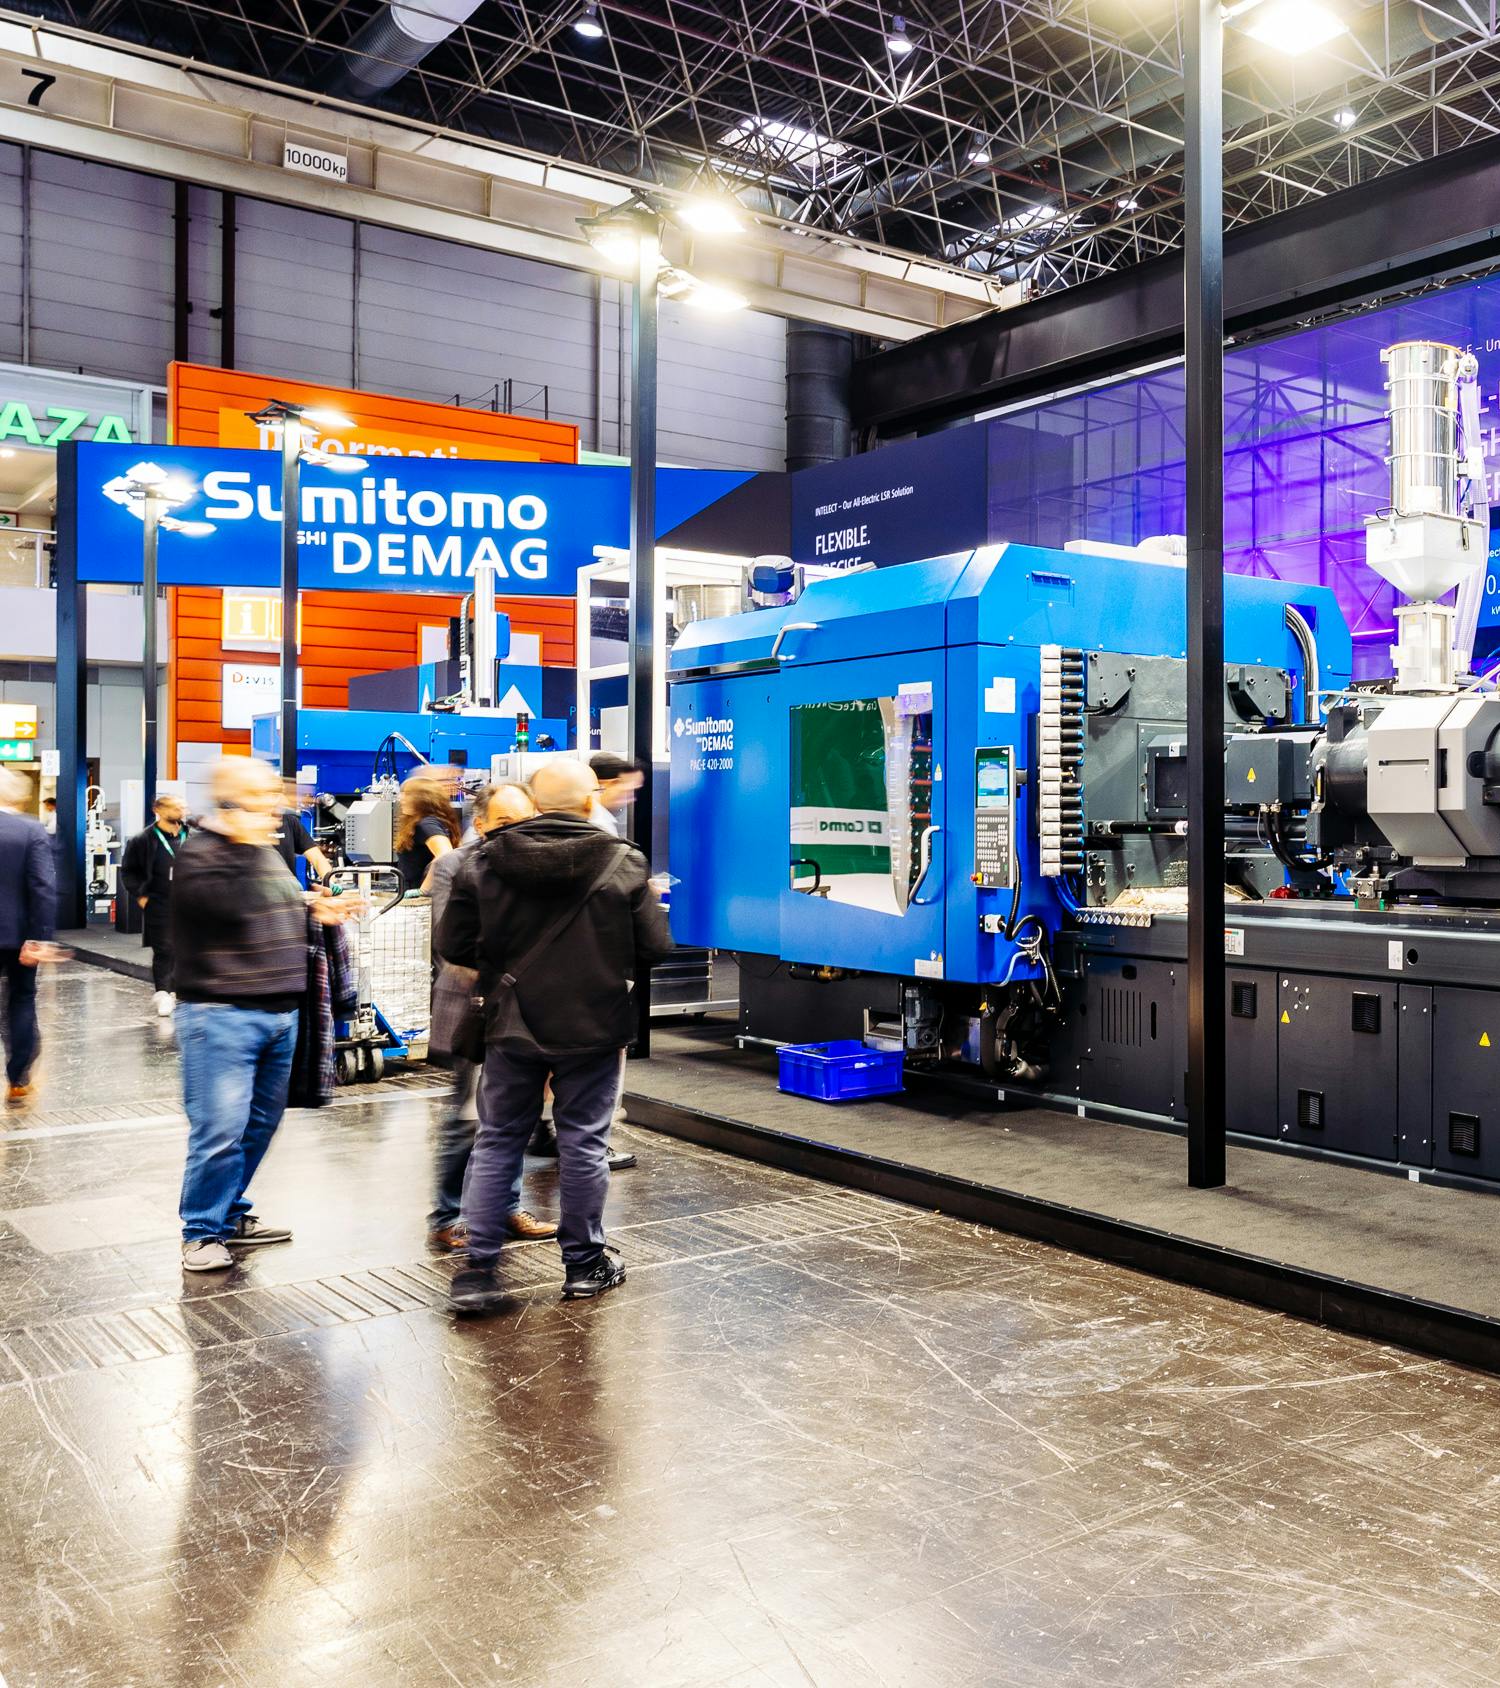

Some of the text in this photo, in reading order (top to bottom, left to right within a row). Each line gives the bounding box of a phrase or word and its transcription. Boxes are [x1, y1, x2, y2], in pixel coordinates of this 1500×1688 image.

[21, 68, 57, 107] 7
[203, 470, 548, 531] Sumitomo
[815, 503, 838, 517] INTELECT
[842, 500, 853, 510] Our
[853, 493, 880, 507] All-Electric
[880, 489, 891, 501] LSR
[891, 486, 914, 499] Solution
[332, 531, 549, 580] DEMAG
[815, 525, 871, 556] FLEXIBLE.
[685, 716, 734, 736] Sumitomo
[701, 735, 734, 752] DEMAG
[706, 757, 734, 770] 420-2000
